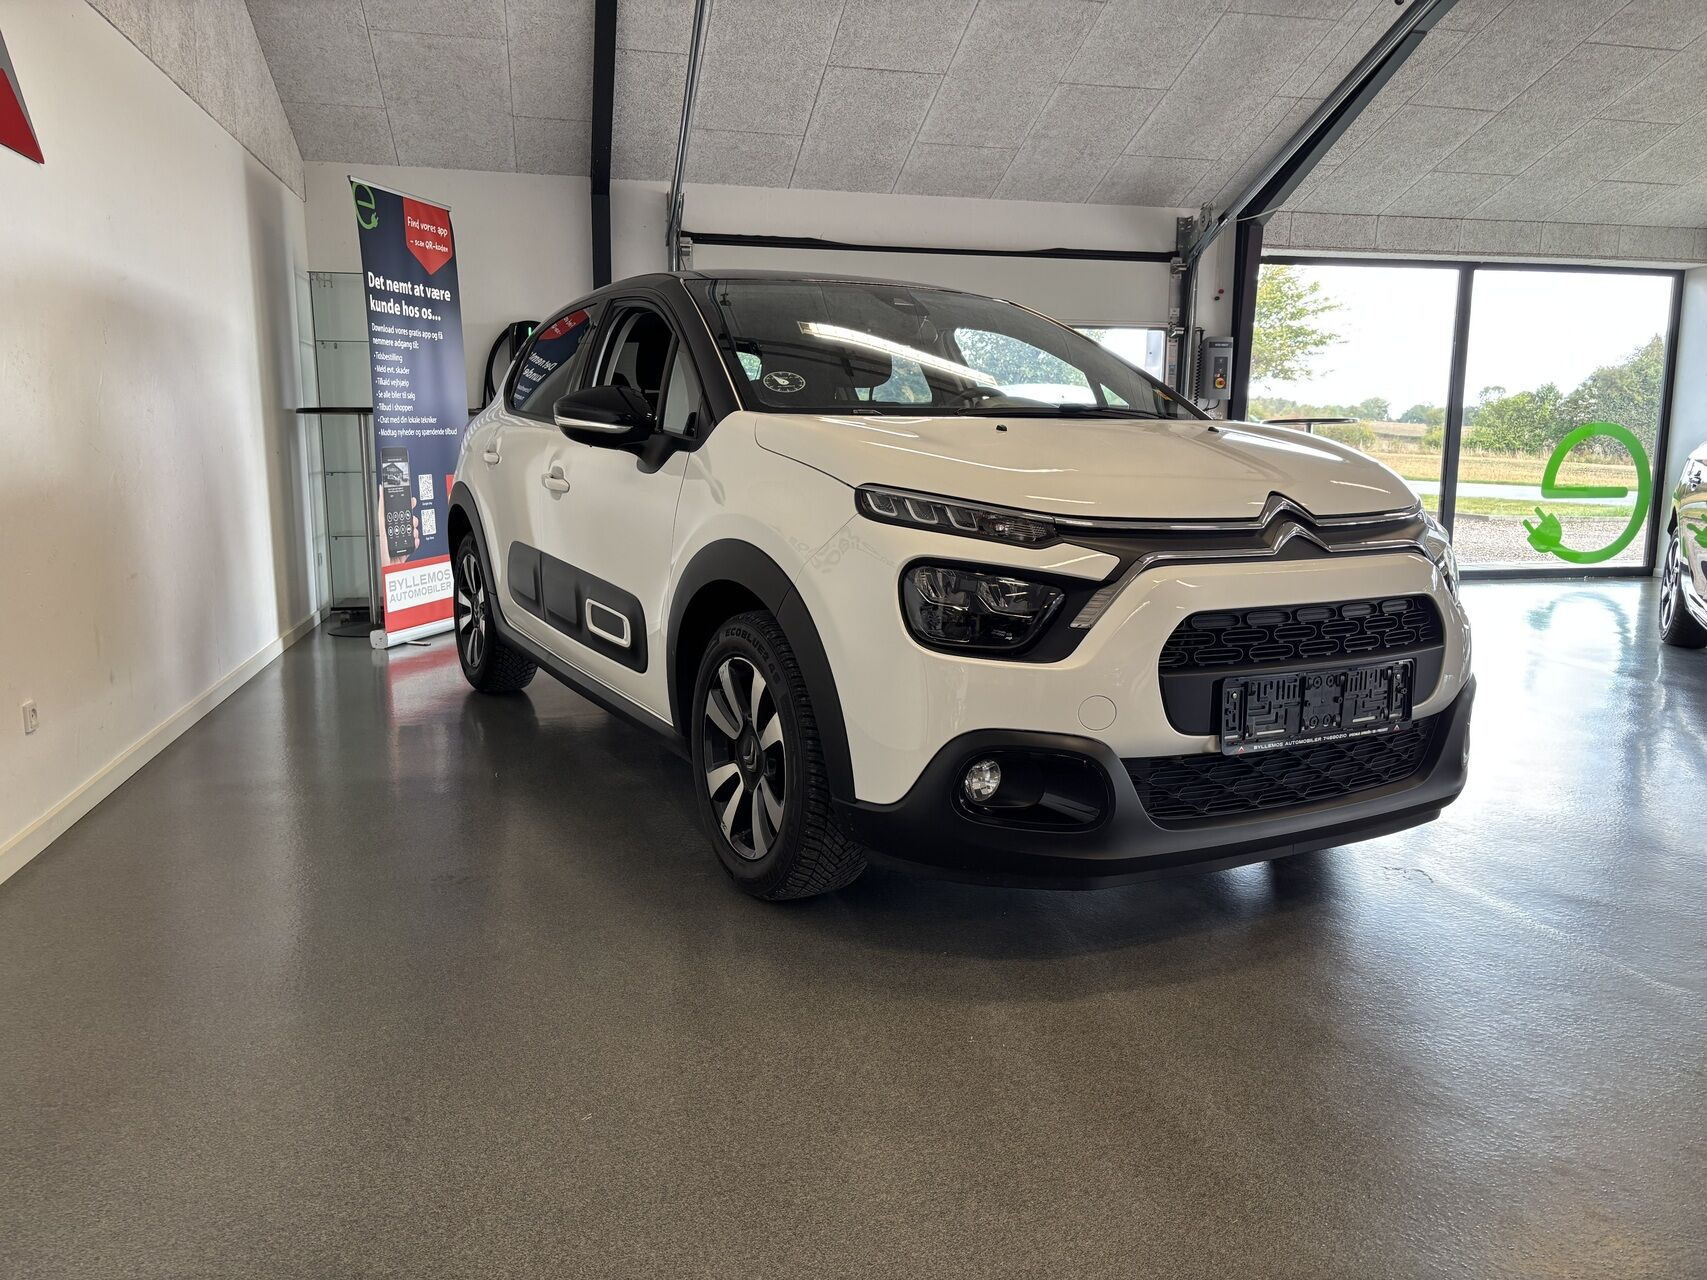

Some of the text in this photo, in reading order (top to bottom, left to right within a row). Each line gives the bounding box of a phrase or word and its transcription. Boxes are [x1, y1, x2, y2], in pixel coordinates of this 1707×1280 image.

[407, 216, 448, 238] Find vores app
[414, 239, 425, 248] scan
[367, 271, 451, 302] Det nemt at være
[369, 294, 441, 321] kunde hos os...
[371, 323, 395, 334] Download
[395, 328, 409, 336] vores
[422, 331, 432, 339] app
[372, 337, 394, 347] nemmere
[394, 339, 413, 350] adgang
[389, 568, 451, 592] BYLLEMOS
[389, 581, 452, 604] AUTOMOBILER
[1253, 742, 1283, 750] BYLLEMOS
[1284, 736, 1322, 746] AUTOMOBILER
